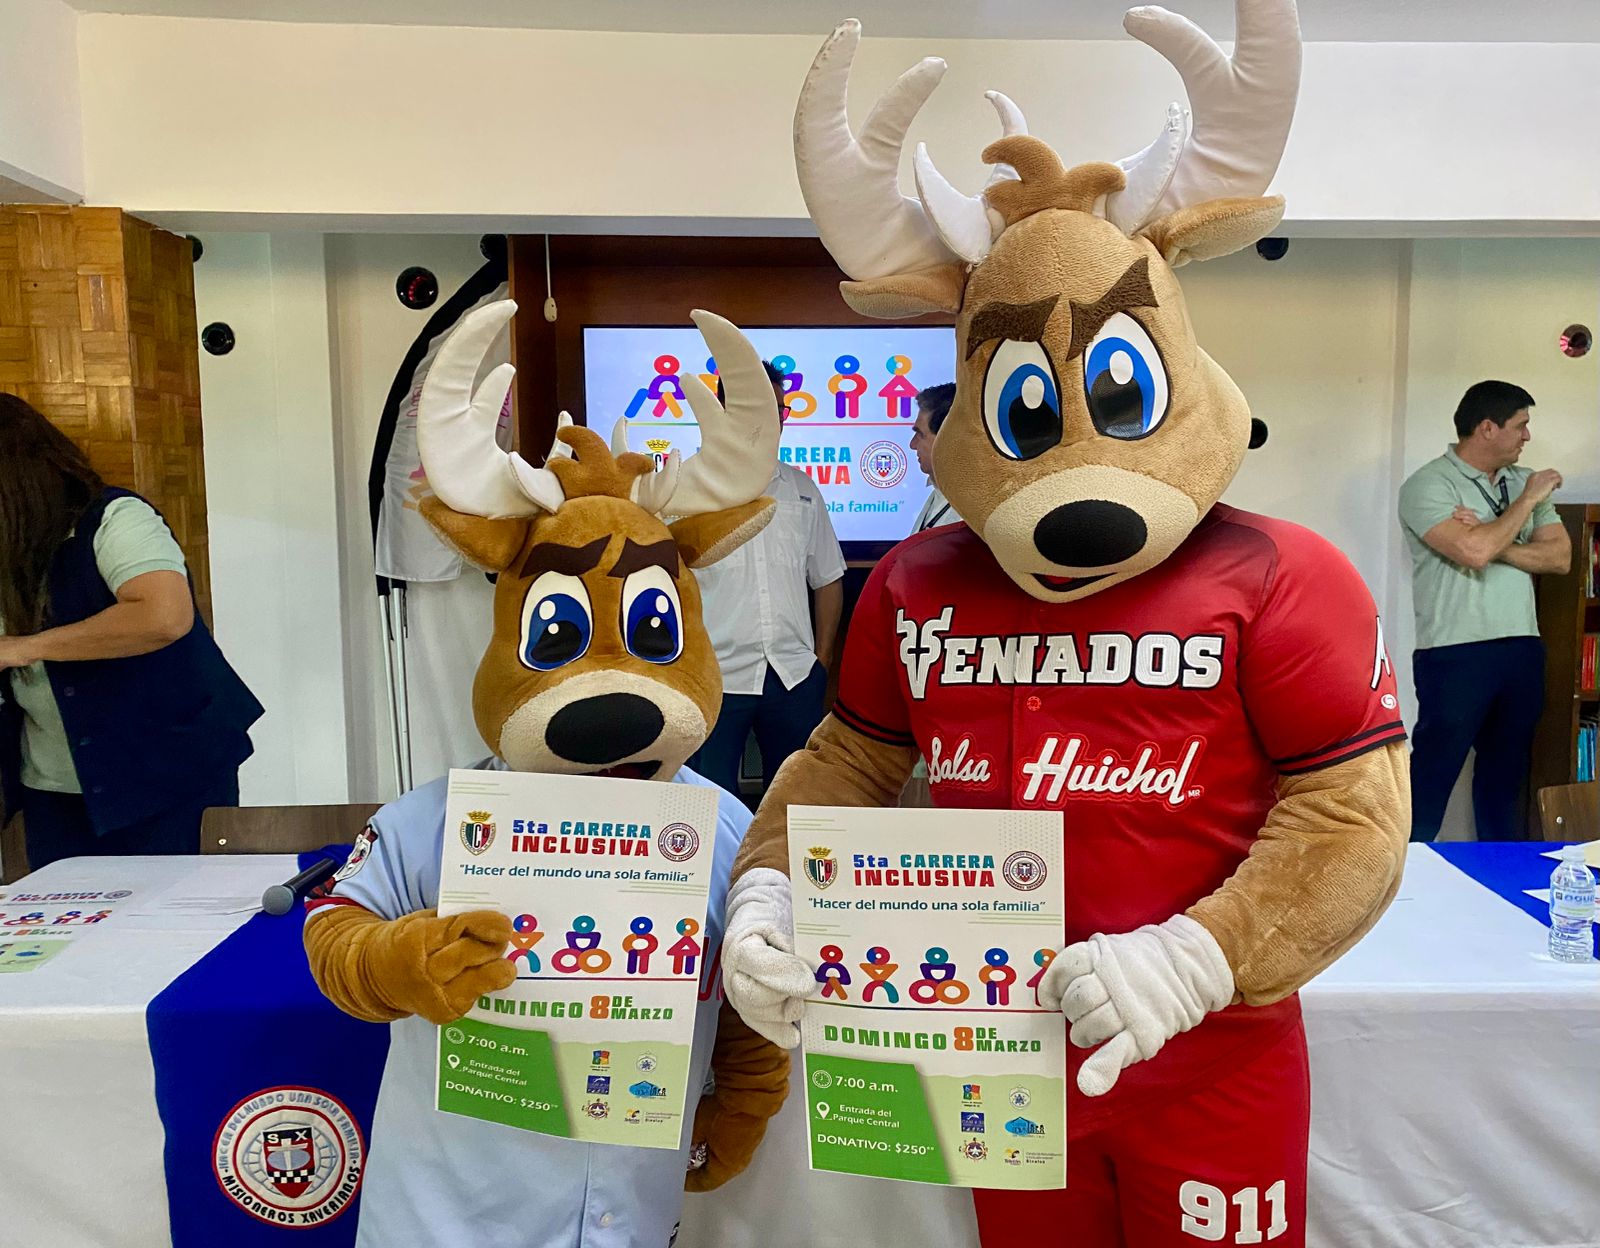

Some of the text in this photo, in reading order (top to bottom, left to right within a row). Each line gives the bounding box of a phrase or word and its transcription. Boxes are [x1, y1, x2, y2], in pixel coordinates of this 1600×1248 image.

[780, 447, 852, 463] RRERA
[826, 501, 844, 513] ola
[896, 607, 1223, 699] VENADOS
[928, 736, 991, 785] Salsa
[1022, 737, 1200, 805] Huichol
[512, 819, 651, 838] 5ta CARRERA
[511, 835, 649, 857] INCLUSIVA
[853, 854, 995, 869] 5ta CARRERA
[508, 865, 530, 877] del
[533, 866, 582, 879] mundo
[585, 870, 611, 880] una
[614, 869, 641, 880] sola
[854, 869, 995, 888] INCLUSIVA
[855, 899, 876, 910] del
[879, 899, 928, 911] mundo
[932, 901, 958, 911] una
[961, 900, 989, 911] sola
[477, 995, 633, 1020] OMINGO 8 DE
[611, 1007, 673, 1020] MARZO
[467, 1034, 529, 1056] 7:00 a.m.
[824, 1024, 997, 1051] DOMINGO 8 DE
[976, 1039, 1041, 1052] MARZO
[463, 1066, 527, 1086] Parque Central
[469, 1059, 520, 1077] Entrada del
[445, 1080, 517, 1105] DONATIVO:
[835, 1076, 898, 1093] 7:00 a.m.
[833, 1113, 900, 1128] Parque Central
[839, 1104, 892, 1118] Entrada del
[218, 1092, 361, 1170] HACER DEL MUNDO UNA SOLA FAMILIA
[267, 1130, 308, 1144] S X
[817, 1133, 891, 1152] DONATIVO:
[222, 1165, 361, 1224] MISIONEROS XAVERIANOS
[1179, 1179, 1288, 1244] 911
